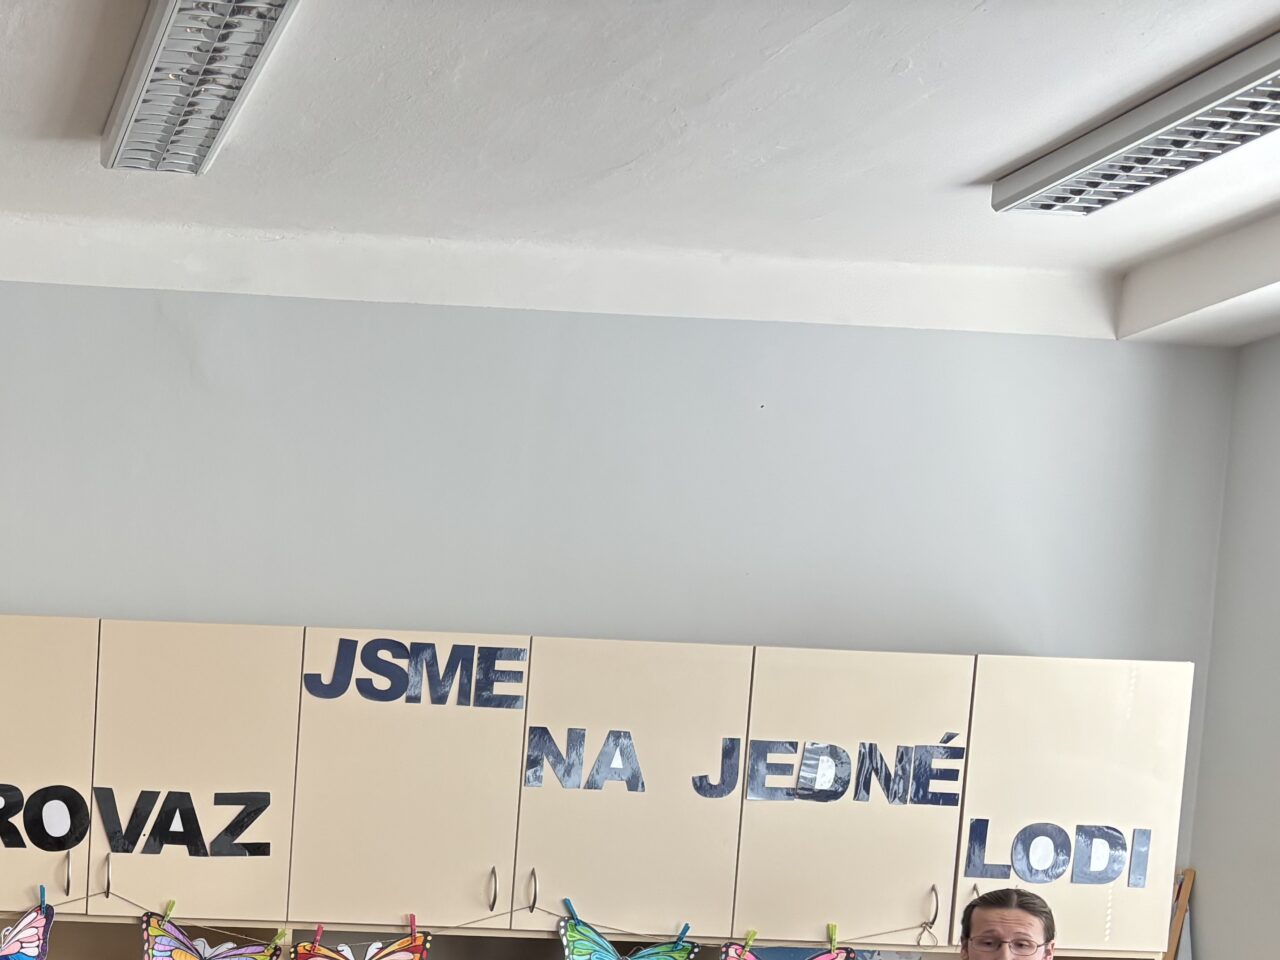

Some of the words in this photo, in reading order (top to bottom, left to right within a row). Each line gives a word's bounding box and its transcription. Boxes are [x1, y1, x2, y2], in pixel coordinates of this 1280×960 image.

[303, 637, 527, 709] JSME
[524, 725, 645, 793] NA
[691, 731, 965, 806] JEDNÉ
[963, 817, 1152, 888] LODI
